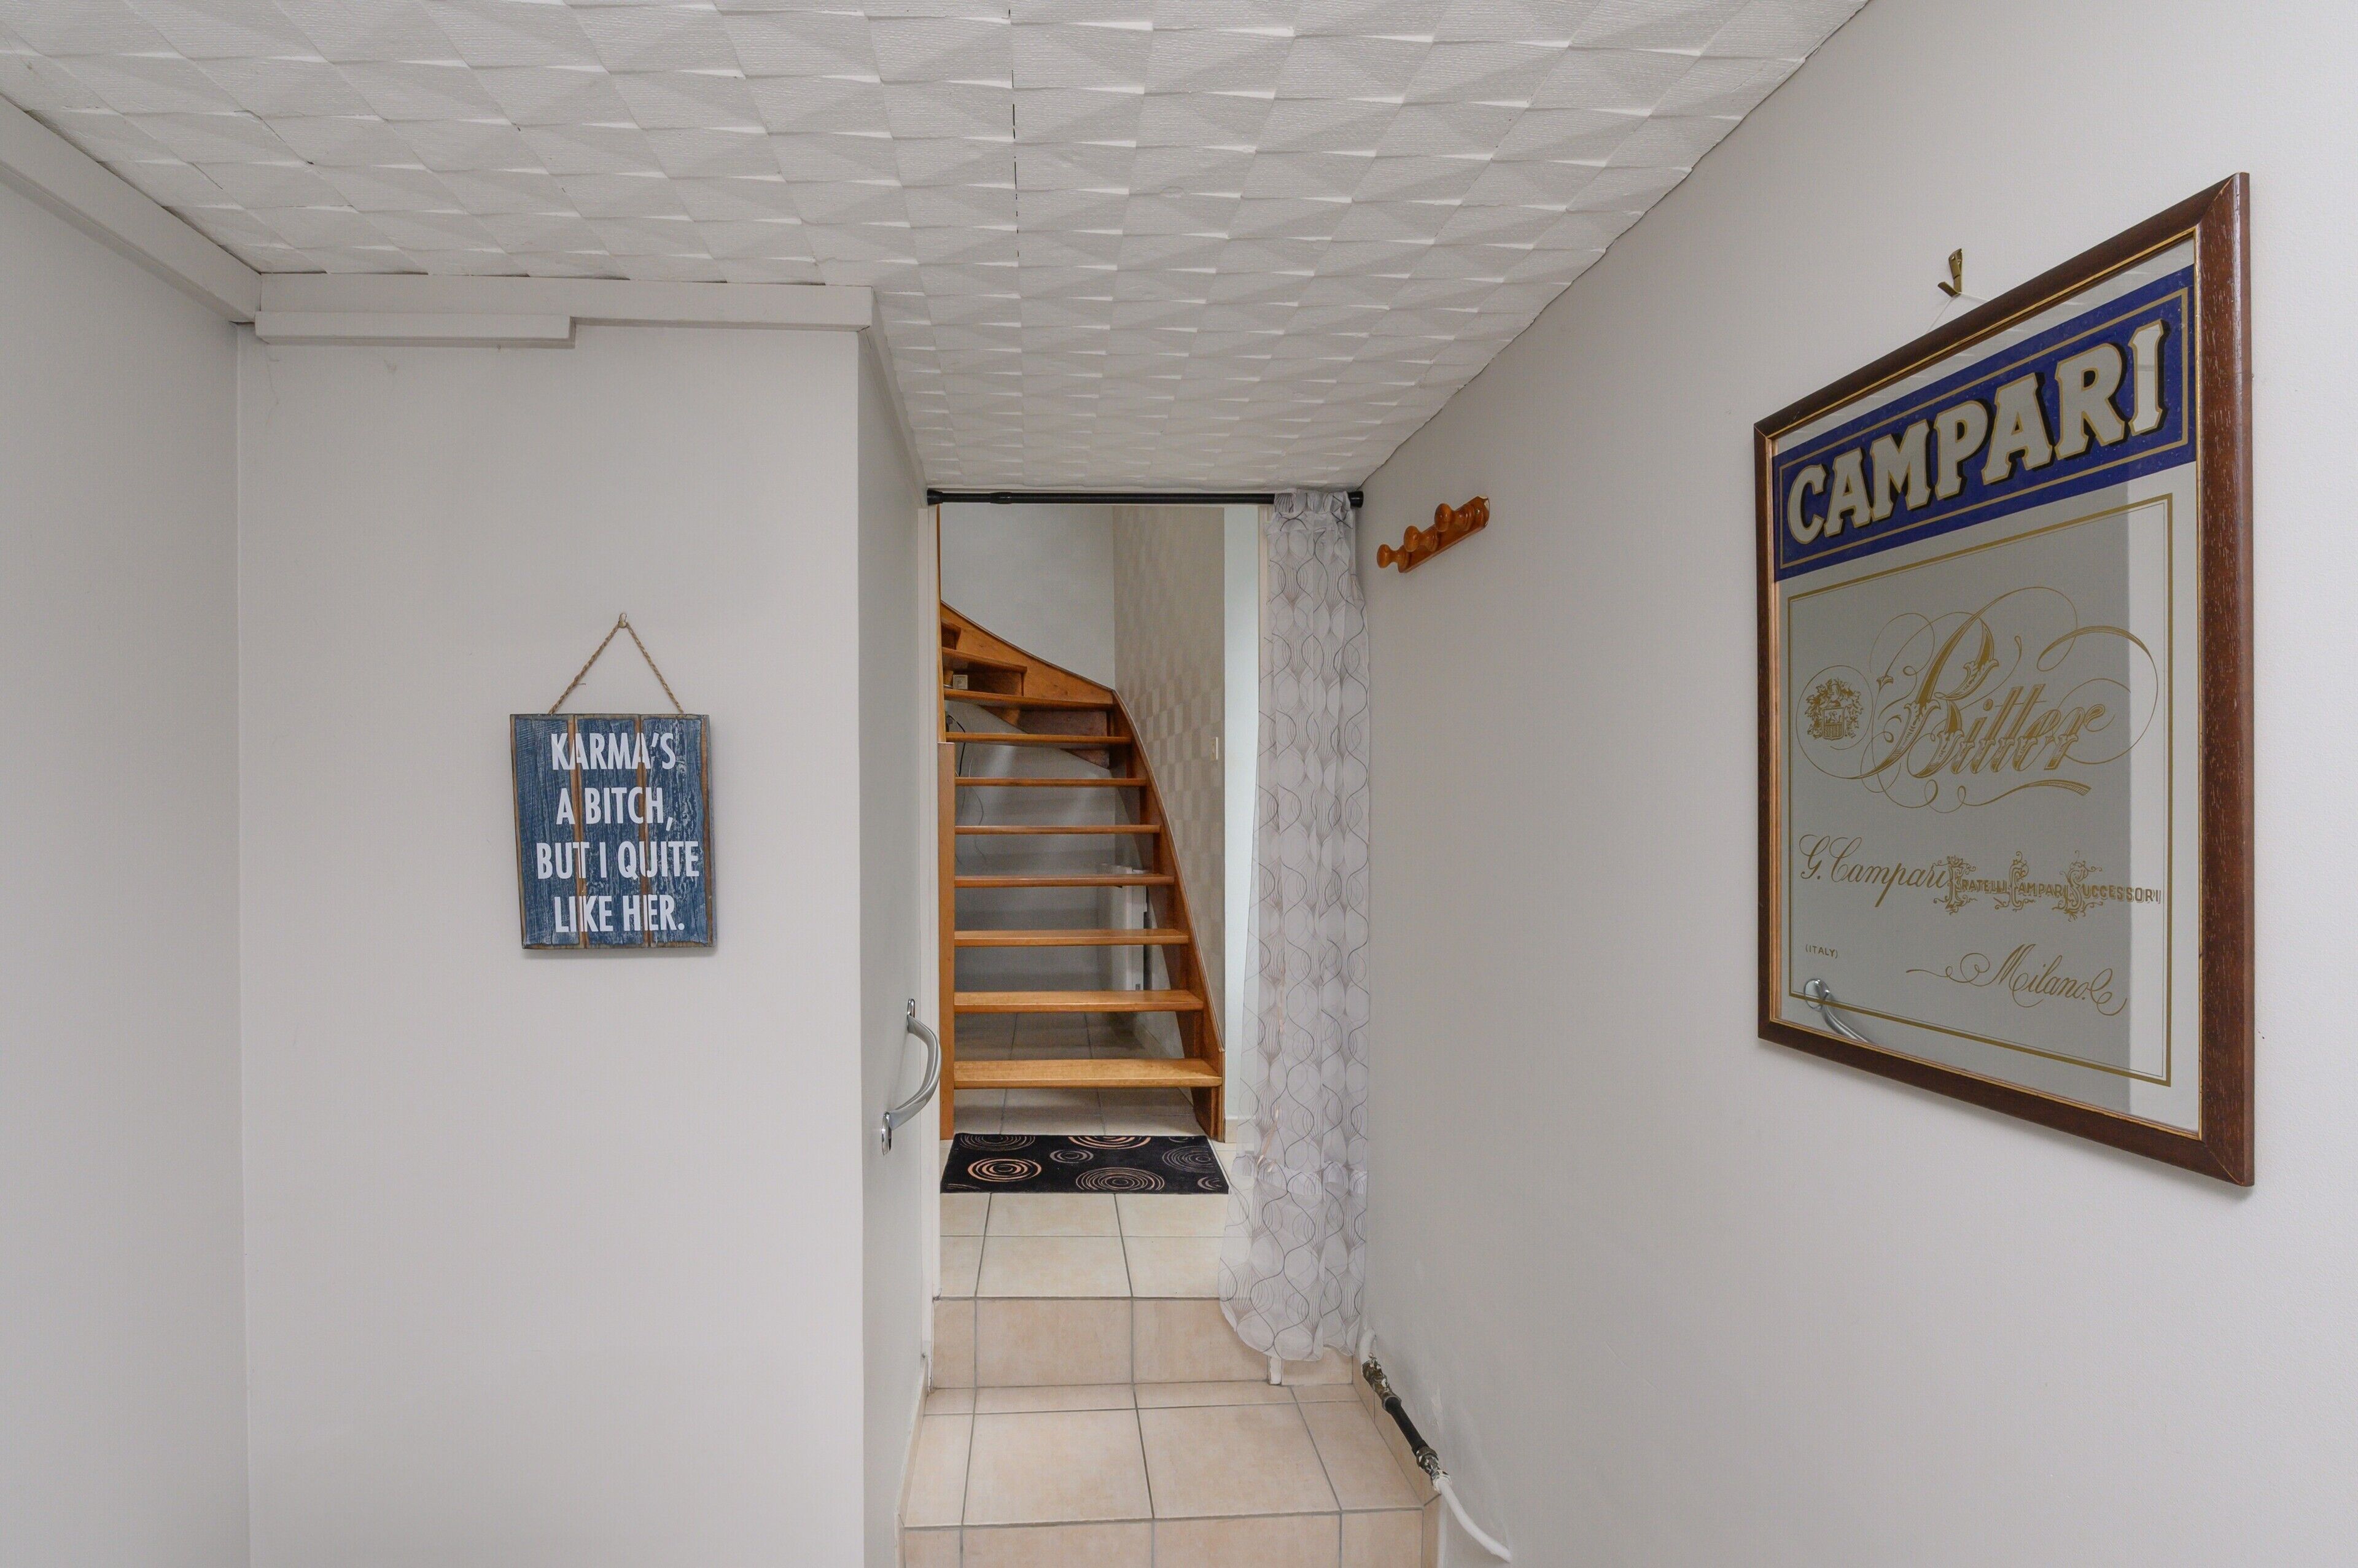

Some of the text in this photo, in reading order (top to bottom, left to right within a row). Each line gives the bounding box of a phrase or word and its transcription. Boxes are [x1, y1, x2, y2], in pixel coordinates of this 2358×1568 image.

[1788, 319, 2170, 545] CAMPARI
[1848, 587, 2131, 798] Bitter
[551, 732, 676, 770] KARMA'S
[556, 787, 673, 831] A BITCH,
[537, 840, 699, 880] BUT I QUITE
[1799, 834, 1831, 879] G.
[1829, 836, 1949, 908] Campari
[554, 895, 685, 933] LIKE HER.
[1805, 944, 1839, 959] (ITALY)
